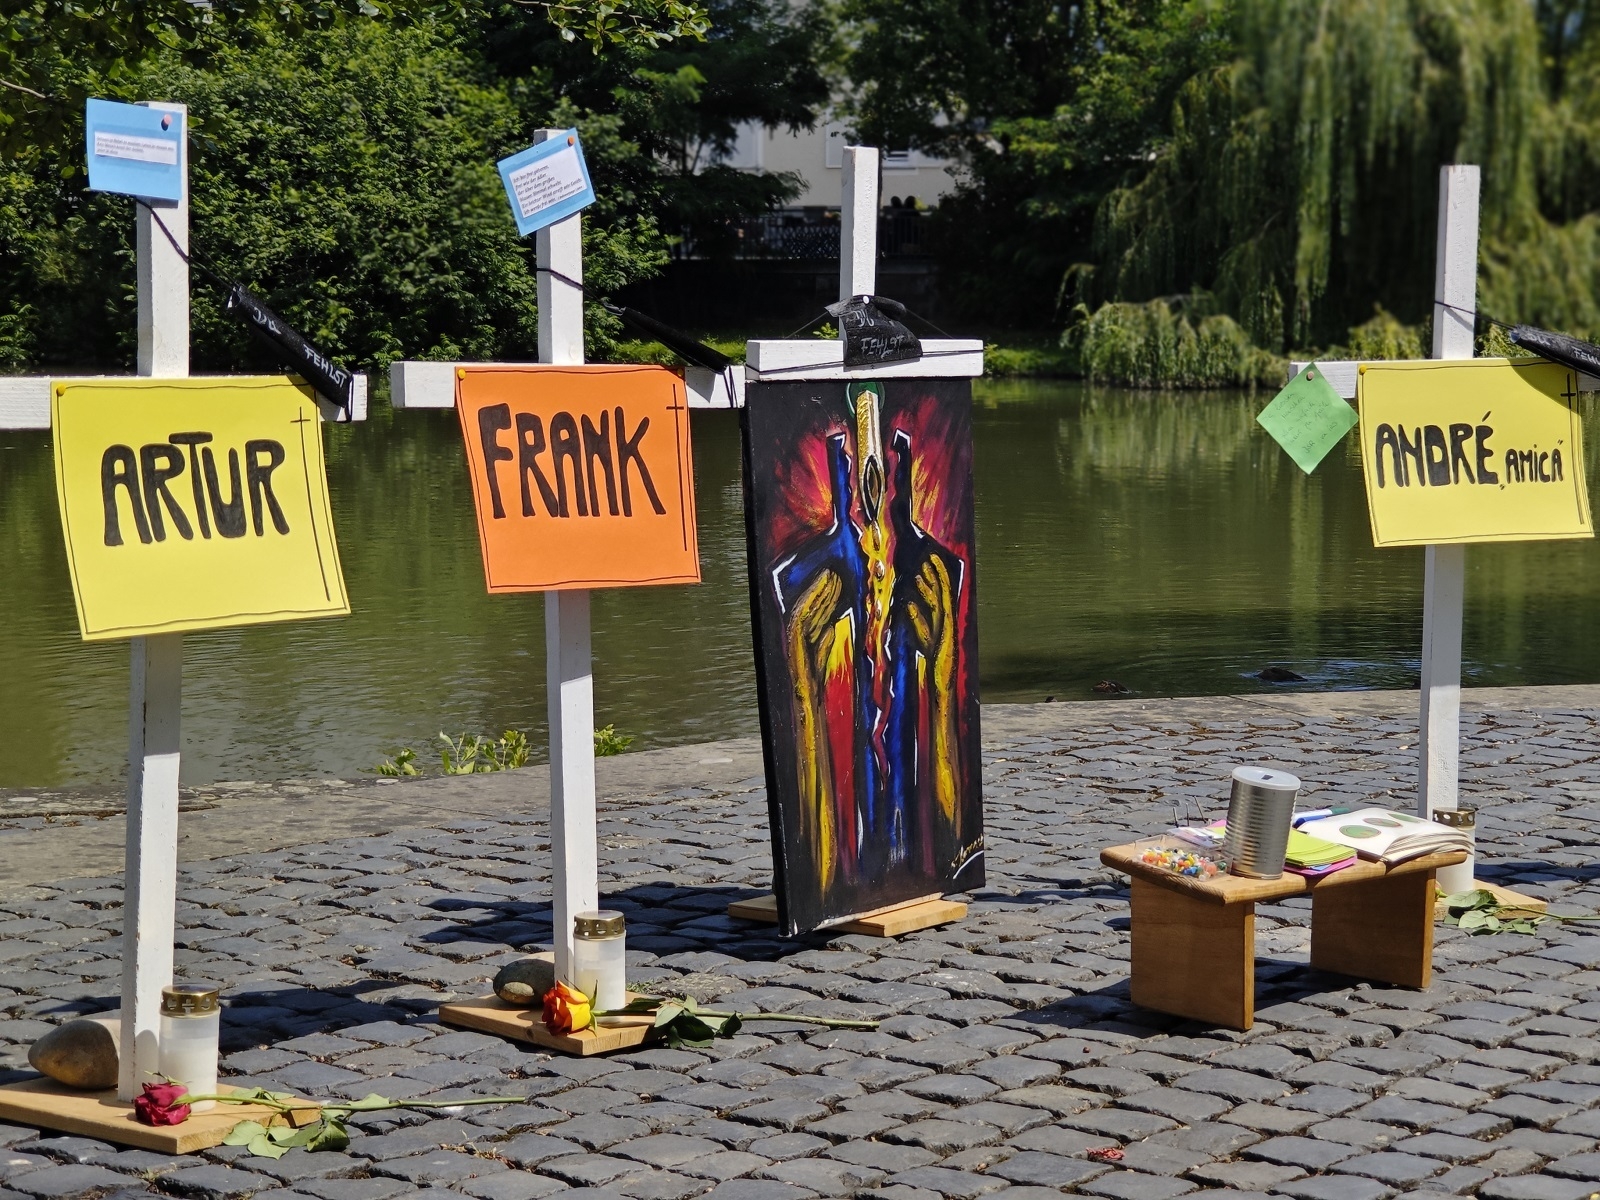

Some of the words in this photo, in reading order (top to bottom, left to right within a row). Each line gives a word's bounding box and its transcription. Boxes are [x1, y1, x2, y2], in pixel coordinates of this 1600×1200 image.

[303, 343, 347, 388] FEHLST
[101, 431, 290, 546] ARTUR
[478, 403, 666, 519] FRANK
[1376, 410, 1498, 488] ANDRÉ
